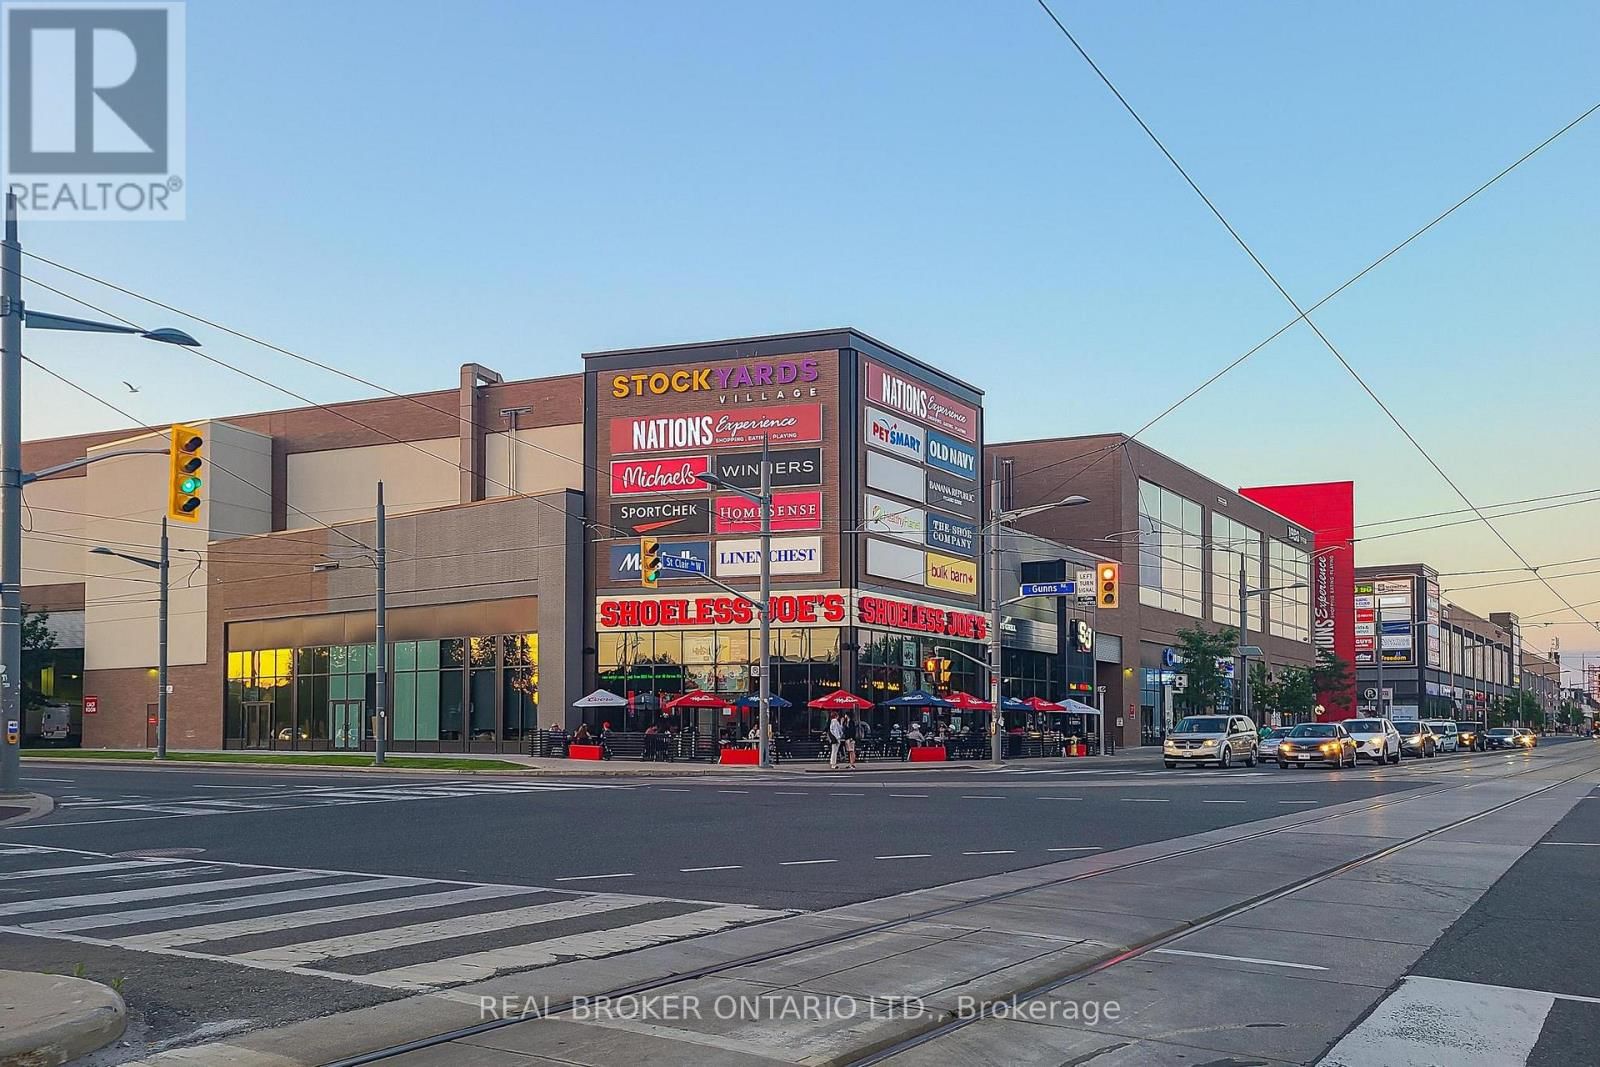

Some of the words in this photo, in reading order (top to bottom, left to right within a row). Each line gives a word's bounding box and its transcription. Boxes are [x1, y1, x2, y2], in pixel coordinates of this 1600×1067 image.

[719, 387, 817, 404] VILLAGE
[882, 372, 928, 419] NATIONS
[927, 395, 967, 423] Experience
[632, 415, 713, 450] NATIONS
[715, 415, 797, 437] Experience
[929, 440, 949, 461] OLD
[949, 447, 975, 471] NAVY
[622, 463, 696, 489] Michaels
[932, 520, 950, 532] THE
[951, 525, 972, 539] SHOE
[932, 531, 972, 549] COMPANY
[675, 558, 689, 569] Clair
[931, 562, 948, 579] bulk
[950, 566, 968, 584] barn
[1032, 584, 1058, 593] Gunns
[1314, 555, 1330, 619] Experience
[600, 596, 752, 628] SHOELESS
[757, 593, 846, 624] JOE'S
[858, 596, 946, 635] SHOELESS
[947, 610, 987, 640] JOE'S
